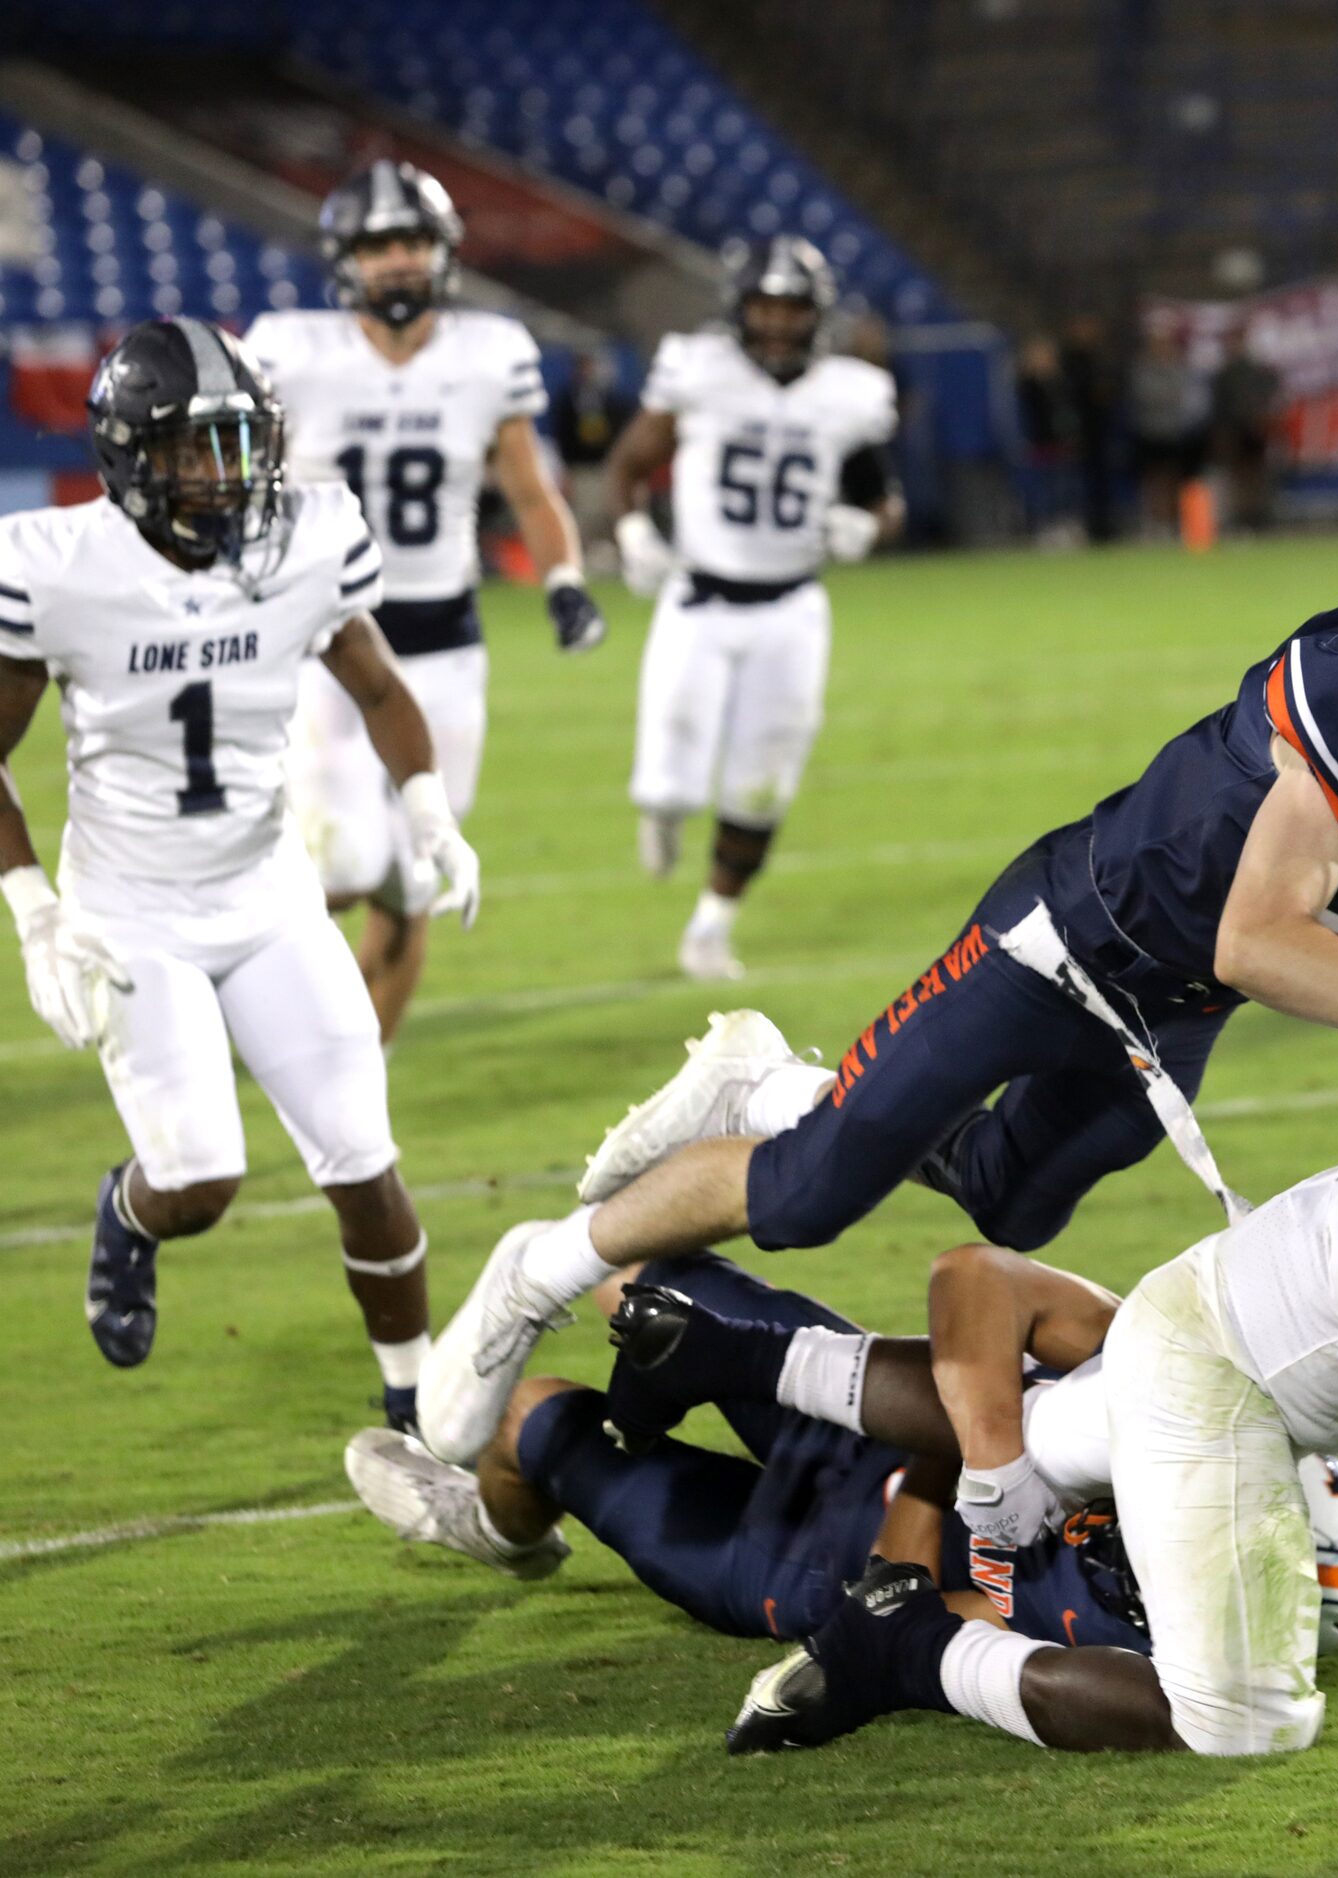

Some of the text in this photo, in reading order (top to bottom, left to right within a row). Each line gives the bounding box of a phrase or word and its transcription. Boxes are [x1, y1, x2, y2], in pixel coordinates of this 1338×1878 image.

[335, 443, 445, 548] 18
[720, 443, 816, 530] 56
[128, 630, 259, 674] LONE STAR
[169, 679, 232, 819] 1
